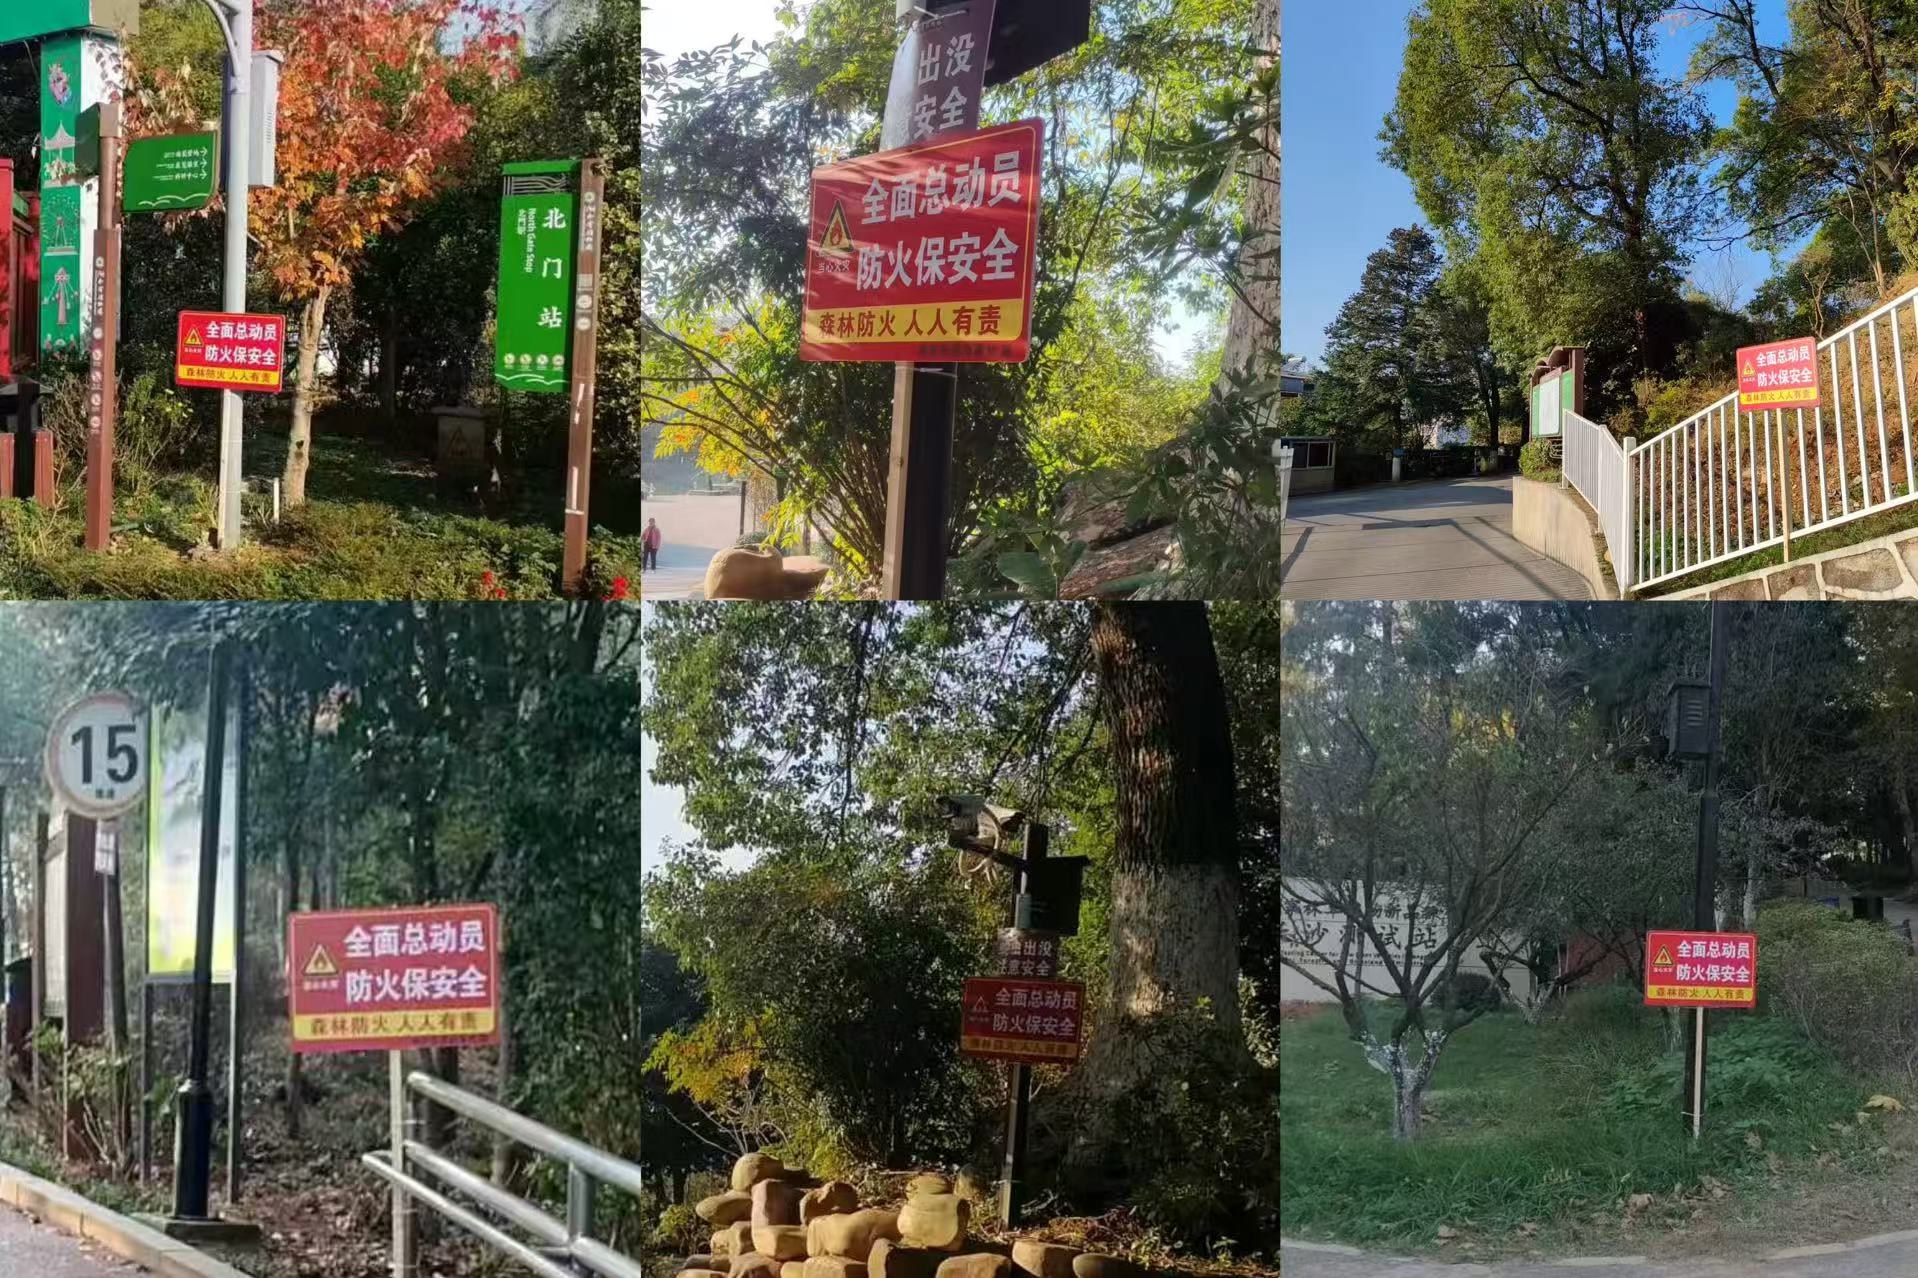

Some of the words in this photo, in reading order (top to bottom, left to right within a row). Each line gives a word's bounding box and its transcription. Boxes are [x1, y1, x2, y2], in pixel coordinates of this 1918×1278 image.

[861, 150, 1022, 225] 全面总动员
[527, 208, 536, 232] North
[526, 233, 536, 253] Gate
[524, 253, 536, 273] Stop
[537, 207, 567, 329] 北门站
[856, 227, 1019, 291] 防火保安全
[205, 320, 278, 341] 全面总动员
[819, 310, 896, 339] 森林防火
[904, 305, 1001, 338] 人人有责
[204, 344, 277, 366] 防火保安全
[1756, 345, 1811, 367] 全面总动员
[1757, 367, 1813, 388] 防火保安全
[71, 725, 138, 784] 15
[344, 920, 485, 958] 全面总动员
[1677, 940, 1750, 959] 全面总动员
[346, 964, 486, 1004] 防火保安全
[1676, 963, 1750, 982] 防火保安全
[995, 987, 1078, 1010] 全面总动员
[993, 1013, 1076, 1036] 防火保安全
